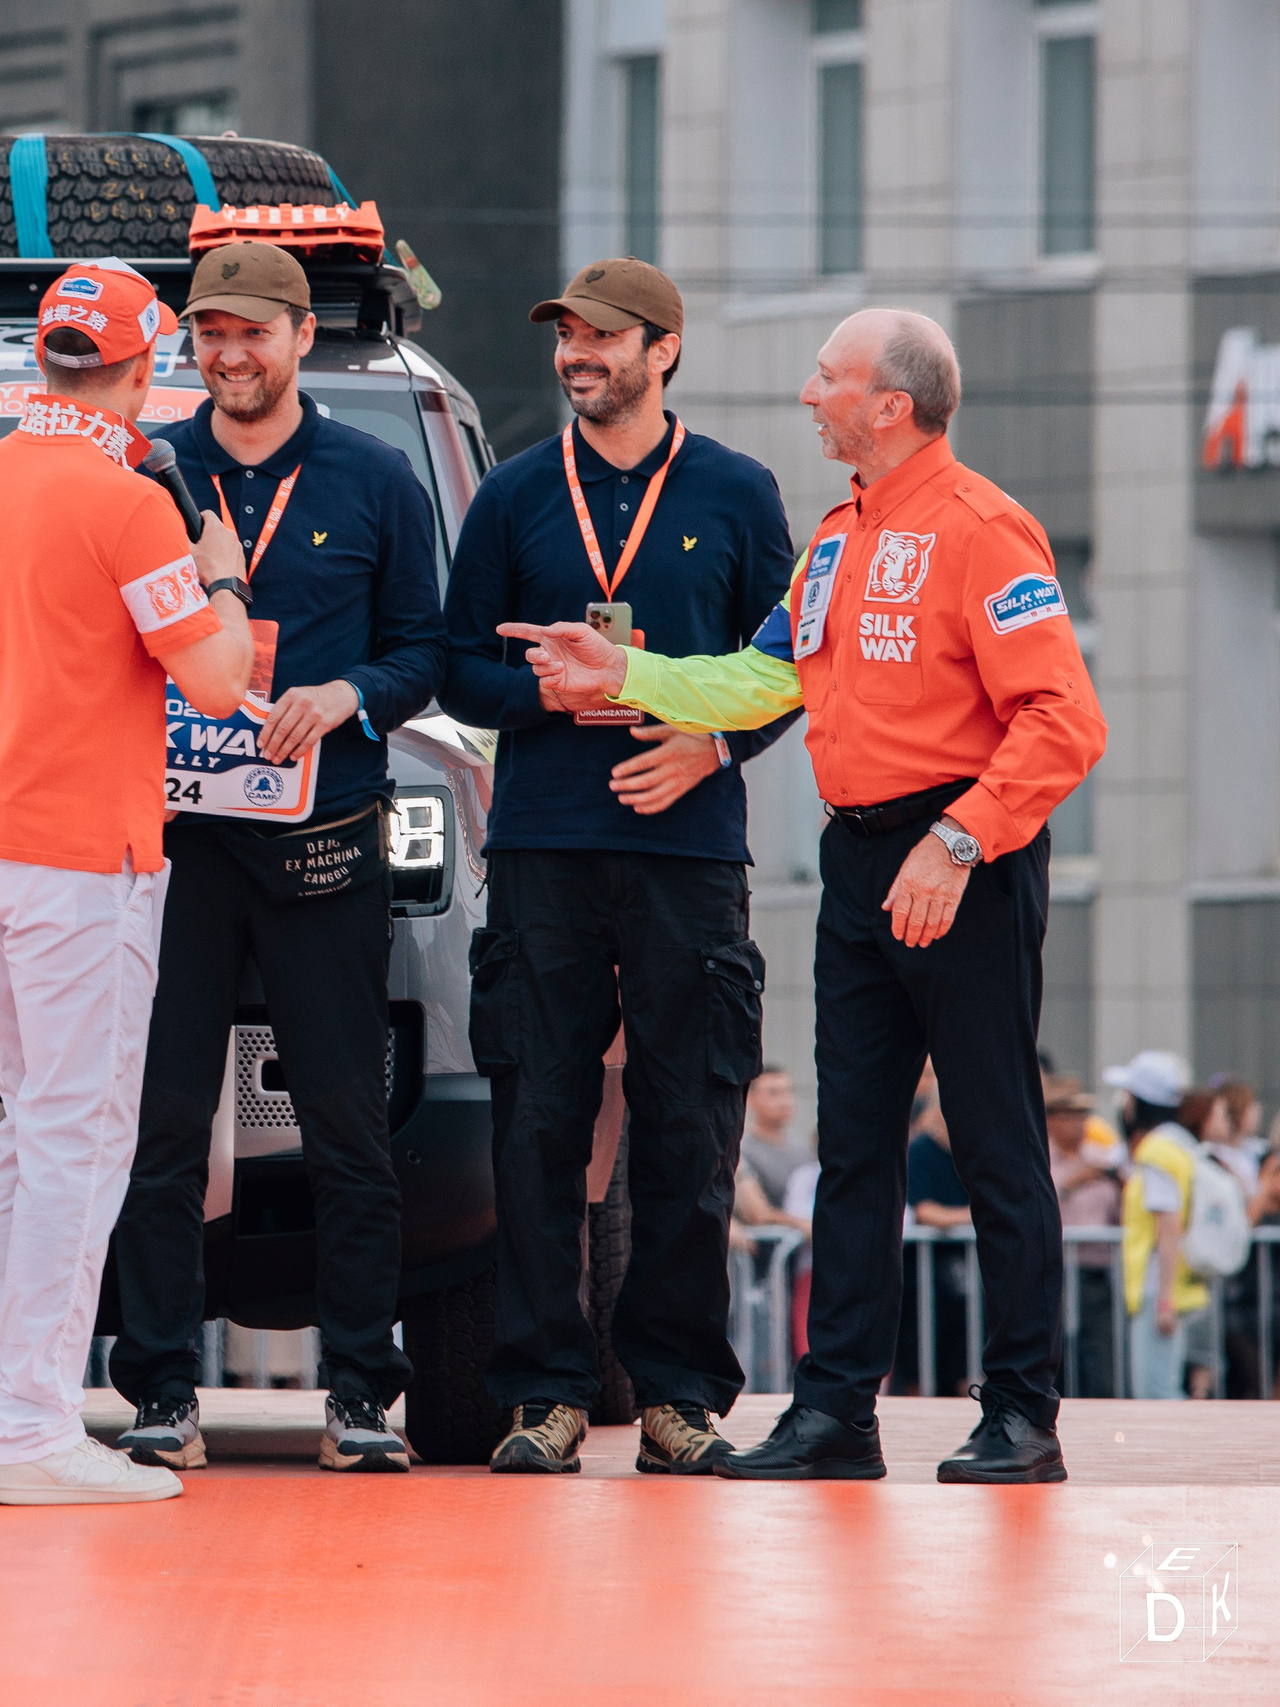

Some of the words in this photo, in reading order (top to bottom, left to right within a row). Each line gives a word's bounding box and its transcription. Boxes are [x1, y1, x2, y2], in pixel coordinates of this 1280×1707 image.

[140, 404, 195, 419] GOL
[996, 591, 1033, 615] SILK
[1033, 586, 1056, 599] WAY
[859, 612, 917, 638] SILK
[859, 636, 917, 662] WAY
[166, 699, 218, 720] 02
[580, 709, 639, 717] ORGANIZATION
[190, 723, 266, 758] WA
[174, 753, 222, 769] LLY
[165, 777, 203, 804] 24
[285, 859, 301, 872] EX
[306, 846, 362, 869] MACHINA
[303, 866, 349, 885] CANGGU
